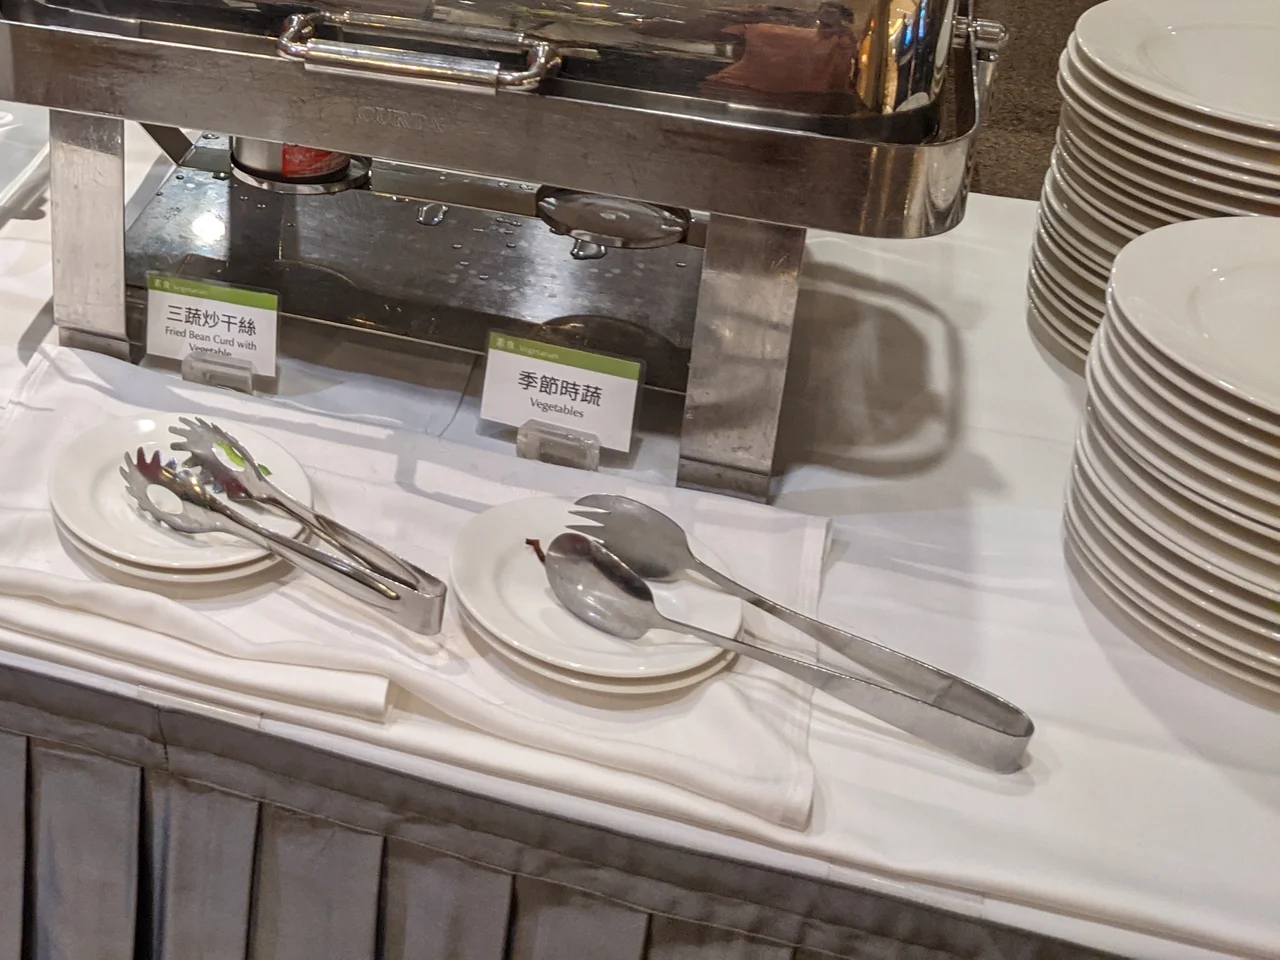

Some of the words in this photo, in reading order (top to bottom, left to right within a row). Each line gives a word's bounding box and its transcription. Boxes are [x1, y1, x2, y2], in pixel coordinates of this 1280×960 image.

[167, 304, 256, 336] 三蔬炒干絲
[165, 326, 187, 338] Fried
[189, 330, 211, 341] Bean
[213, 334, 235, 346] Curd
[236, 340, 257, 351] with
[518, 370, 603, 407] 季節時蔬
[530, 397, 584, 418] Vegetables
